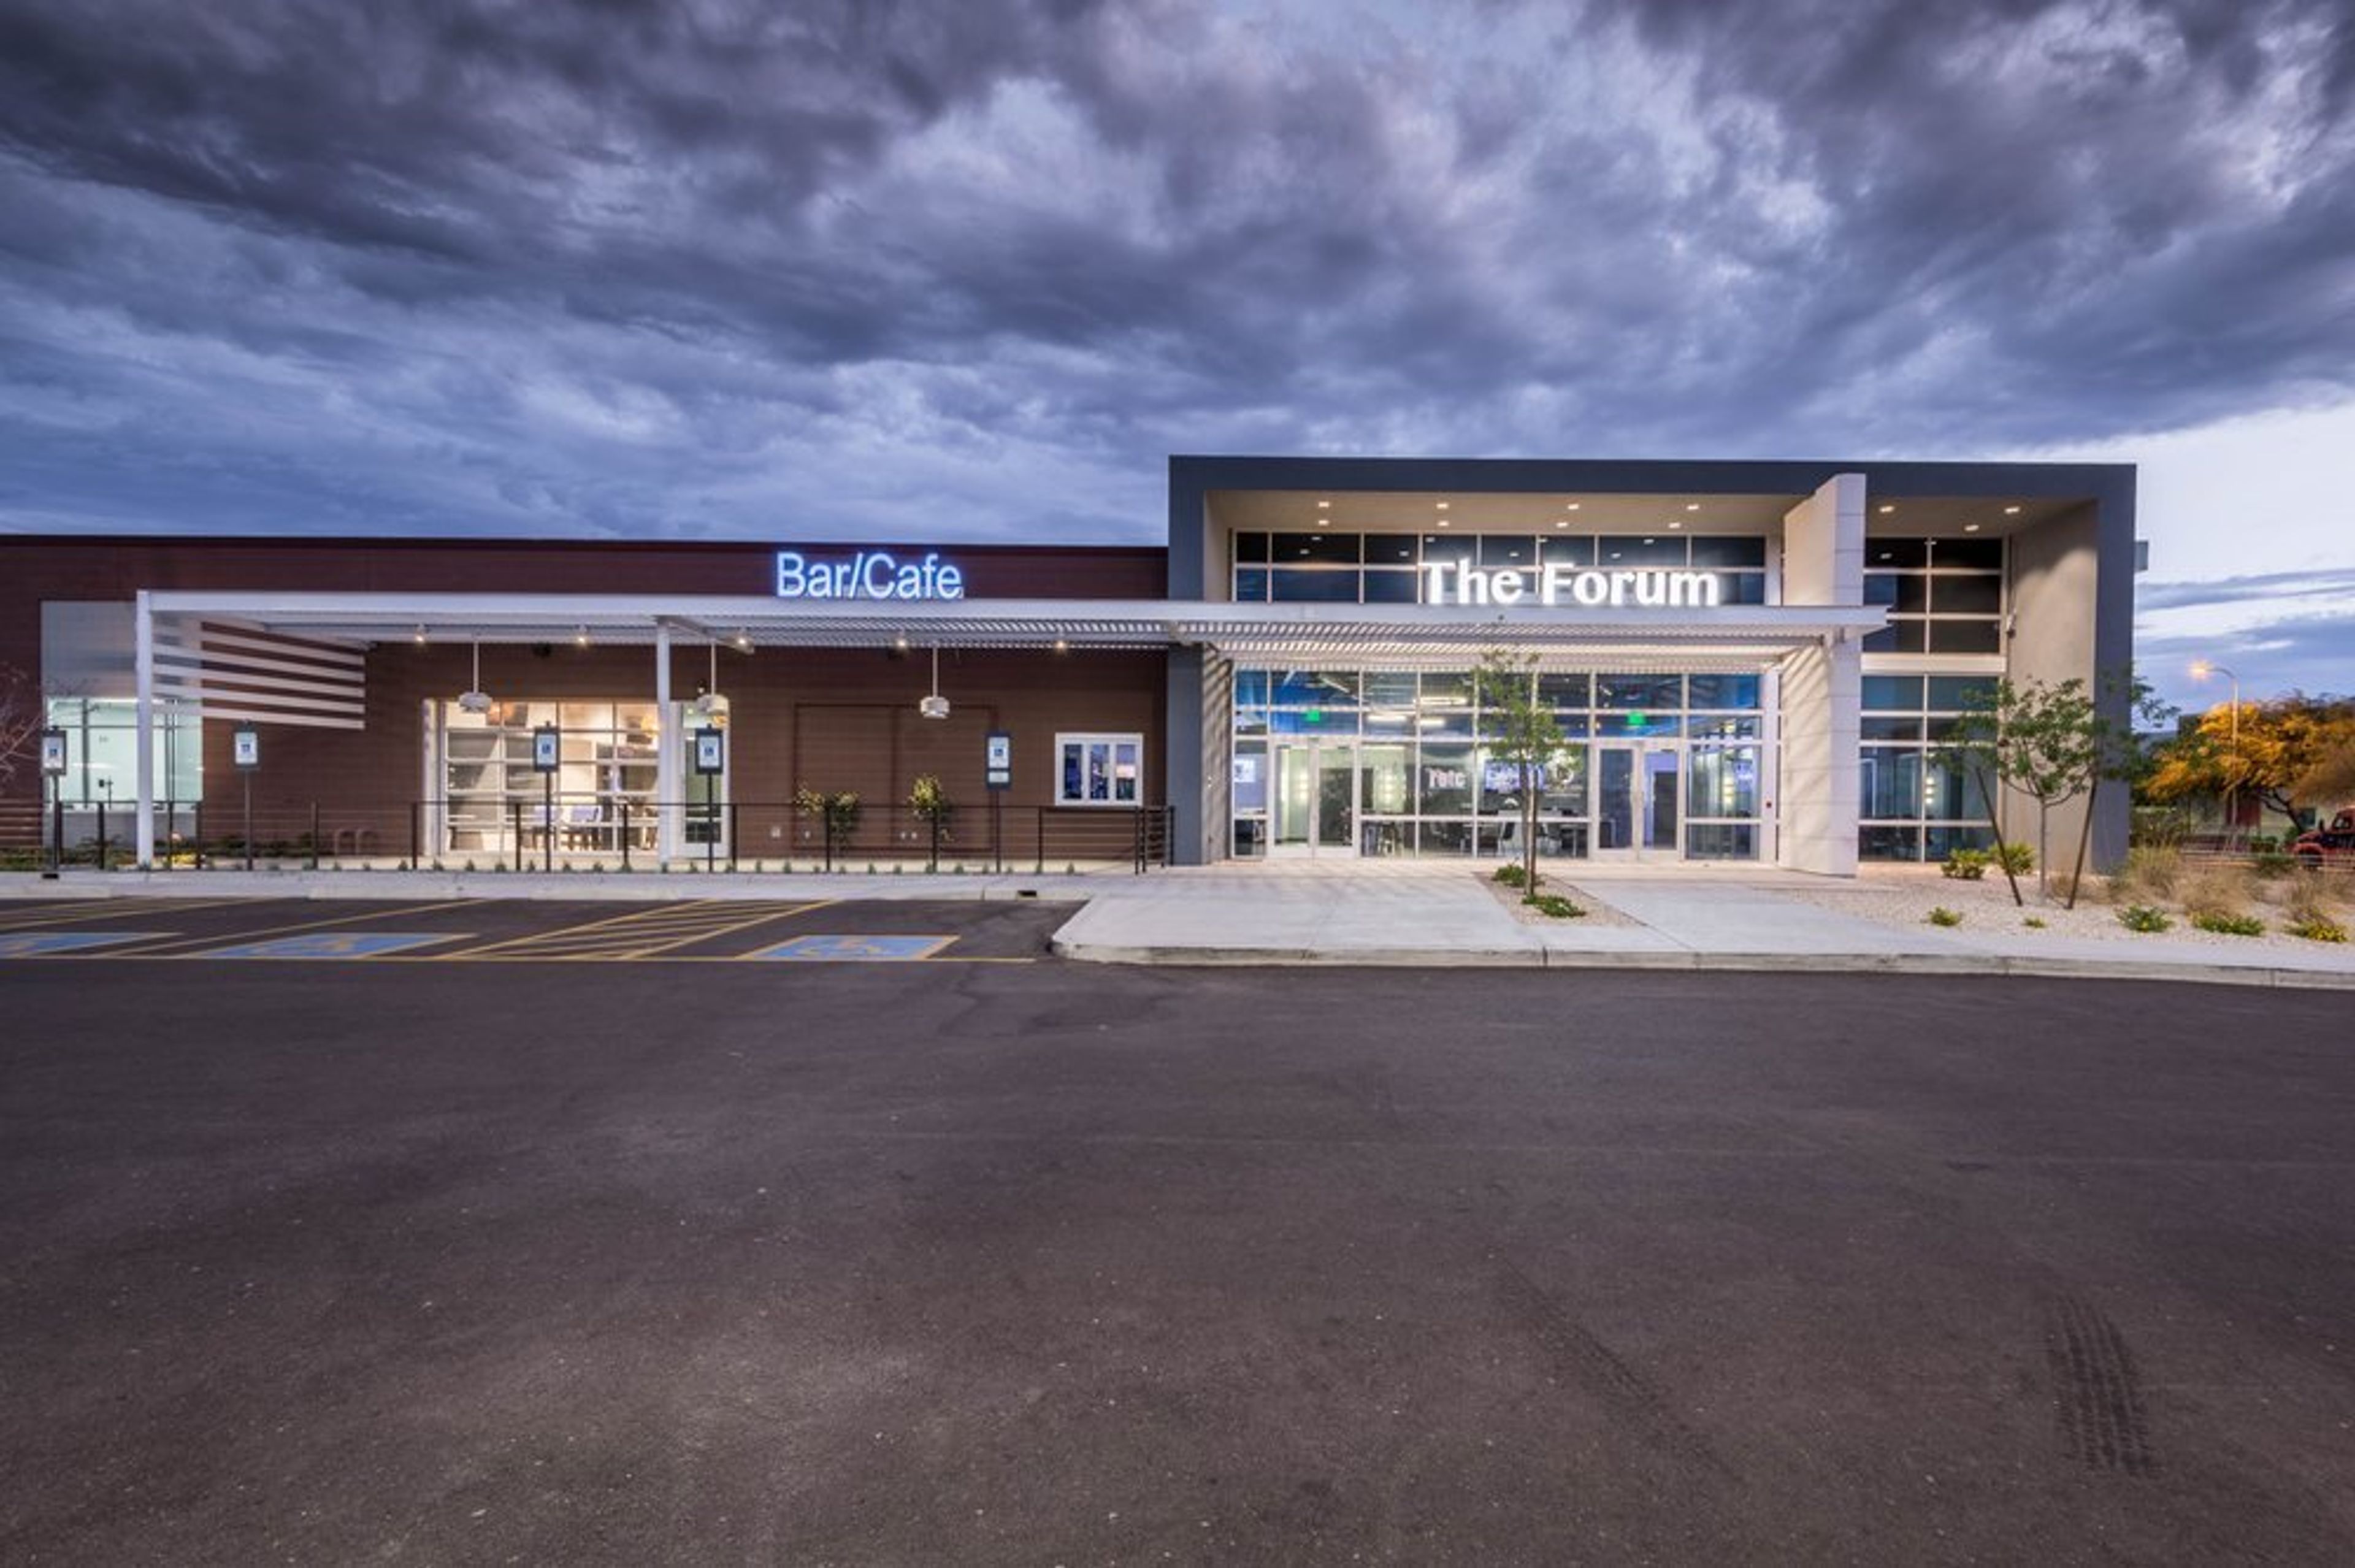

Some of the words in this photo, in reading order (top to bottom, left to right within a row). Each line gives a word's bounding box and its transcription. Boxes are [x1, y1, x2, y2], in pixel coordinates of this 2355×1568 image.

[776, 551, 963, 599] Bar/Cafe
[1419, 558, 1525, 605] The
[1542, 562, 1719, 606] Forum
